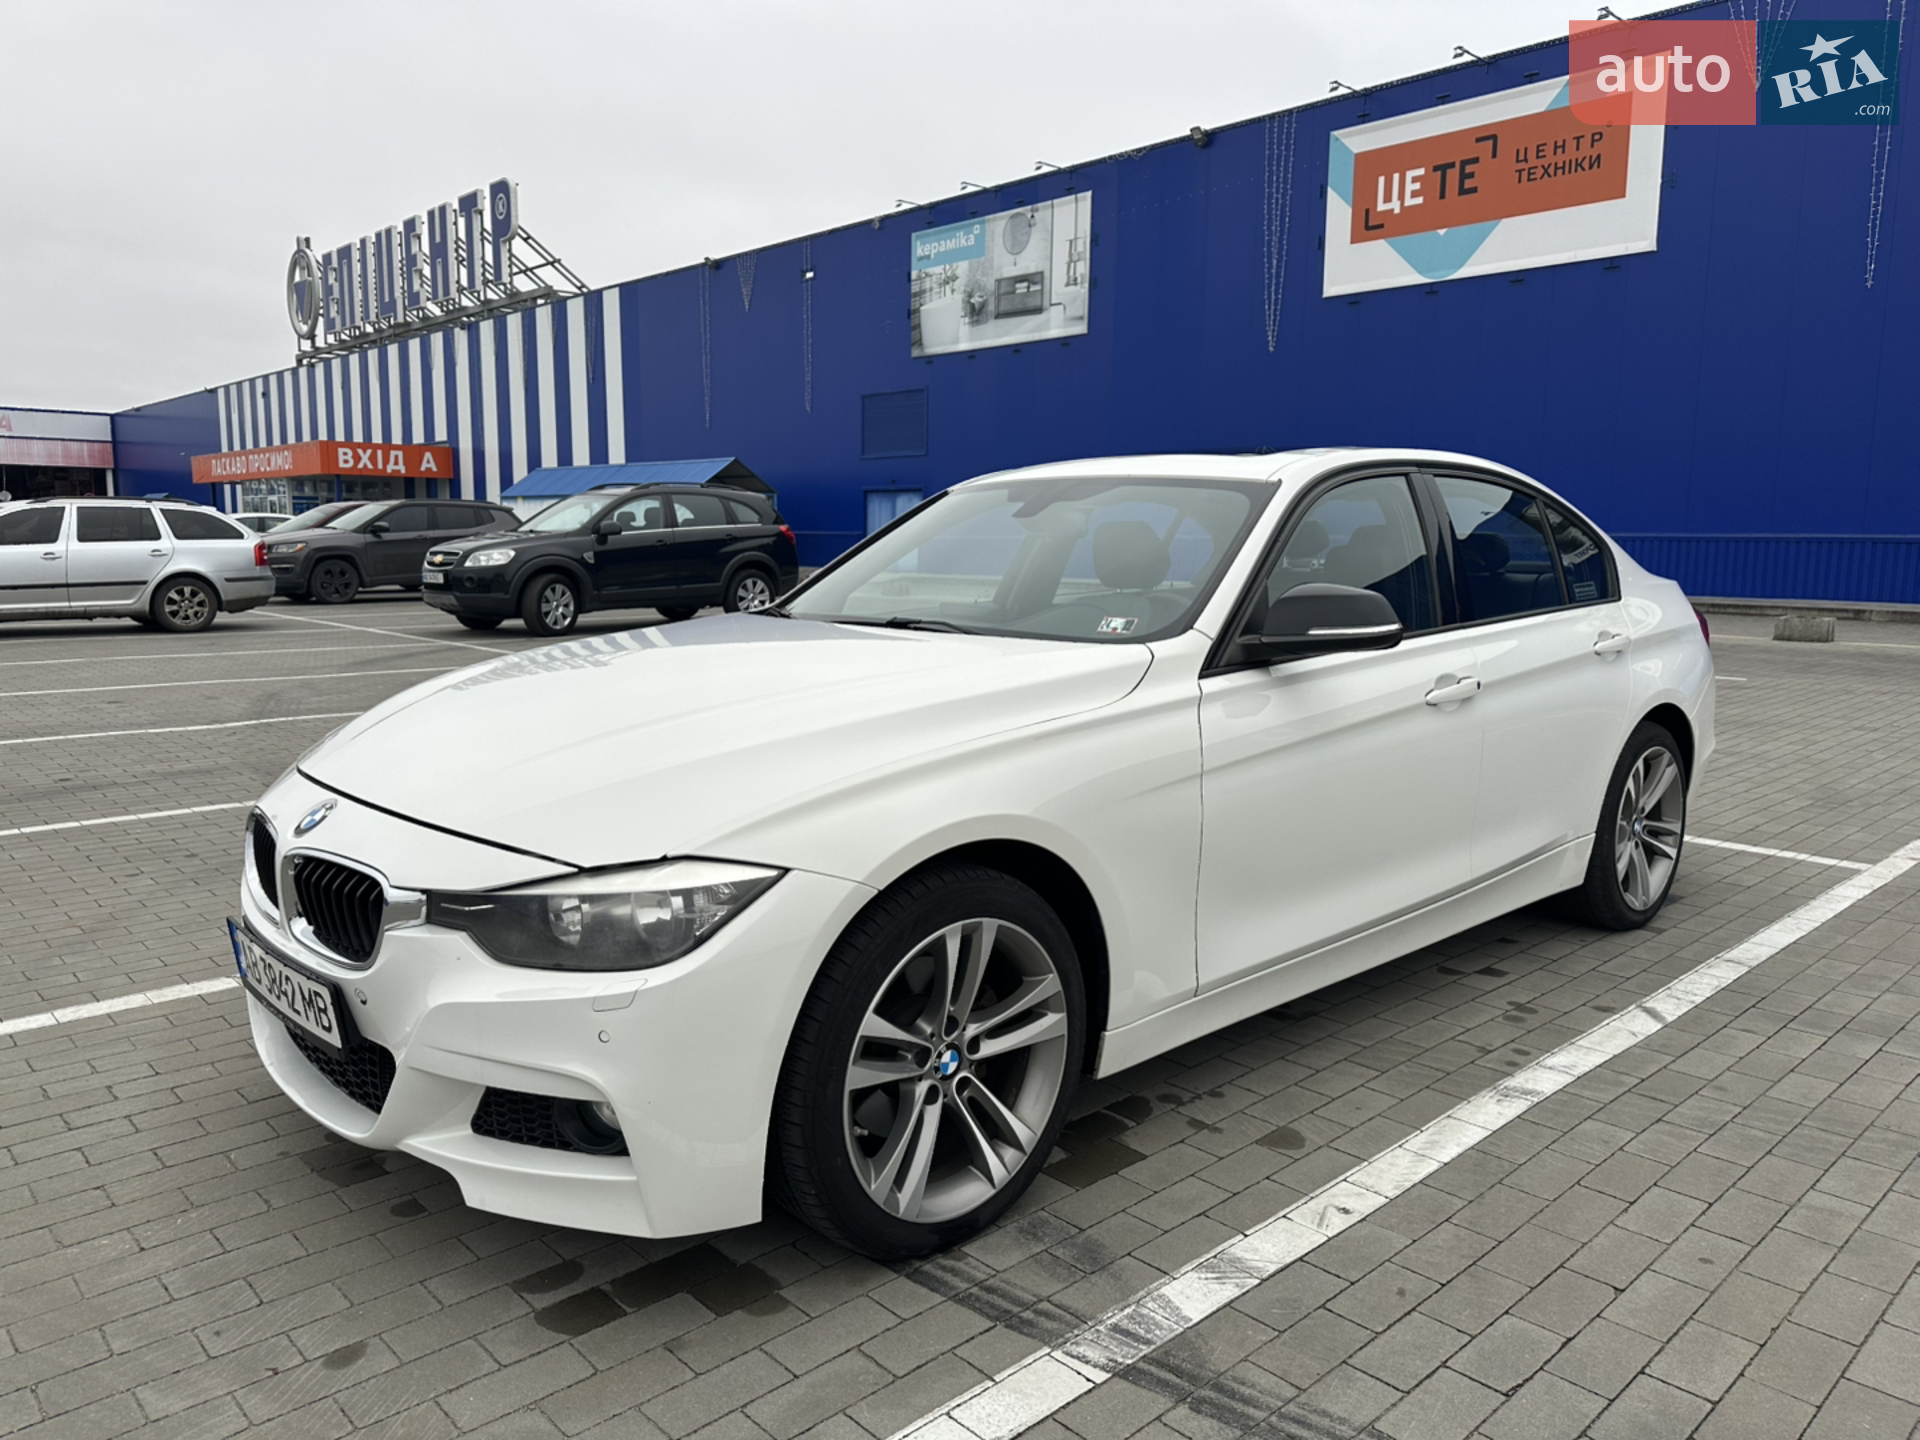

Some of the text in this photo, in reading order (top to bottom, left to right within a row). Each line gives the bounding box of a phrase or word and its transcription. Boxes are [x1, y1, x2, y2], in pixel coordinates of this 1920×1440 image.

[1515, 131, 1604, 165] ЦЕНТР
[1376, 156, 1480, 214] ЦЕ ТЕ
[1514, 153, 1602, 184] ТЕХНІКИ
[321, 177, 518, 334] ЕПІЦЕНТР
[211, 450, 293, 476] ЛАСКАВО ПРОСИМО!
[337, 448, 438, 474] ВХІД А
[260, 956, 301, 1017] 3842
[297, 981, 332, 1034] MB
